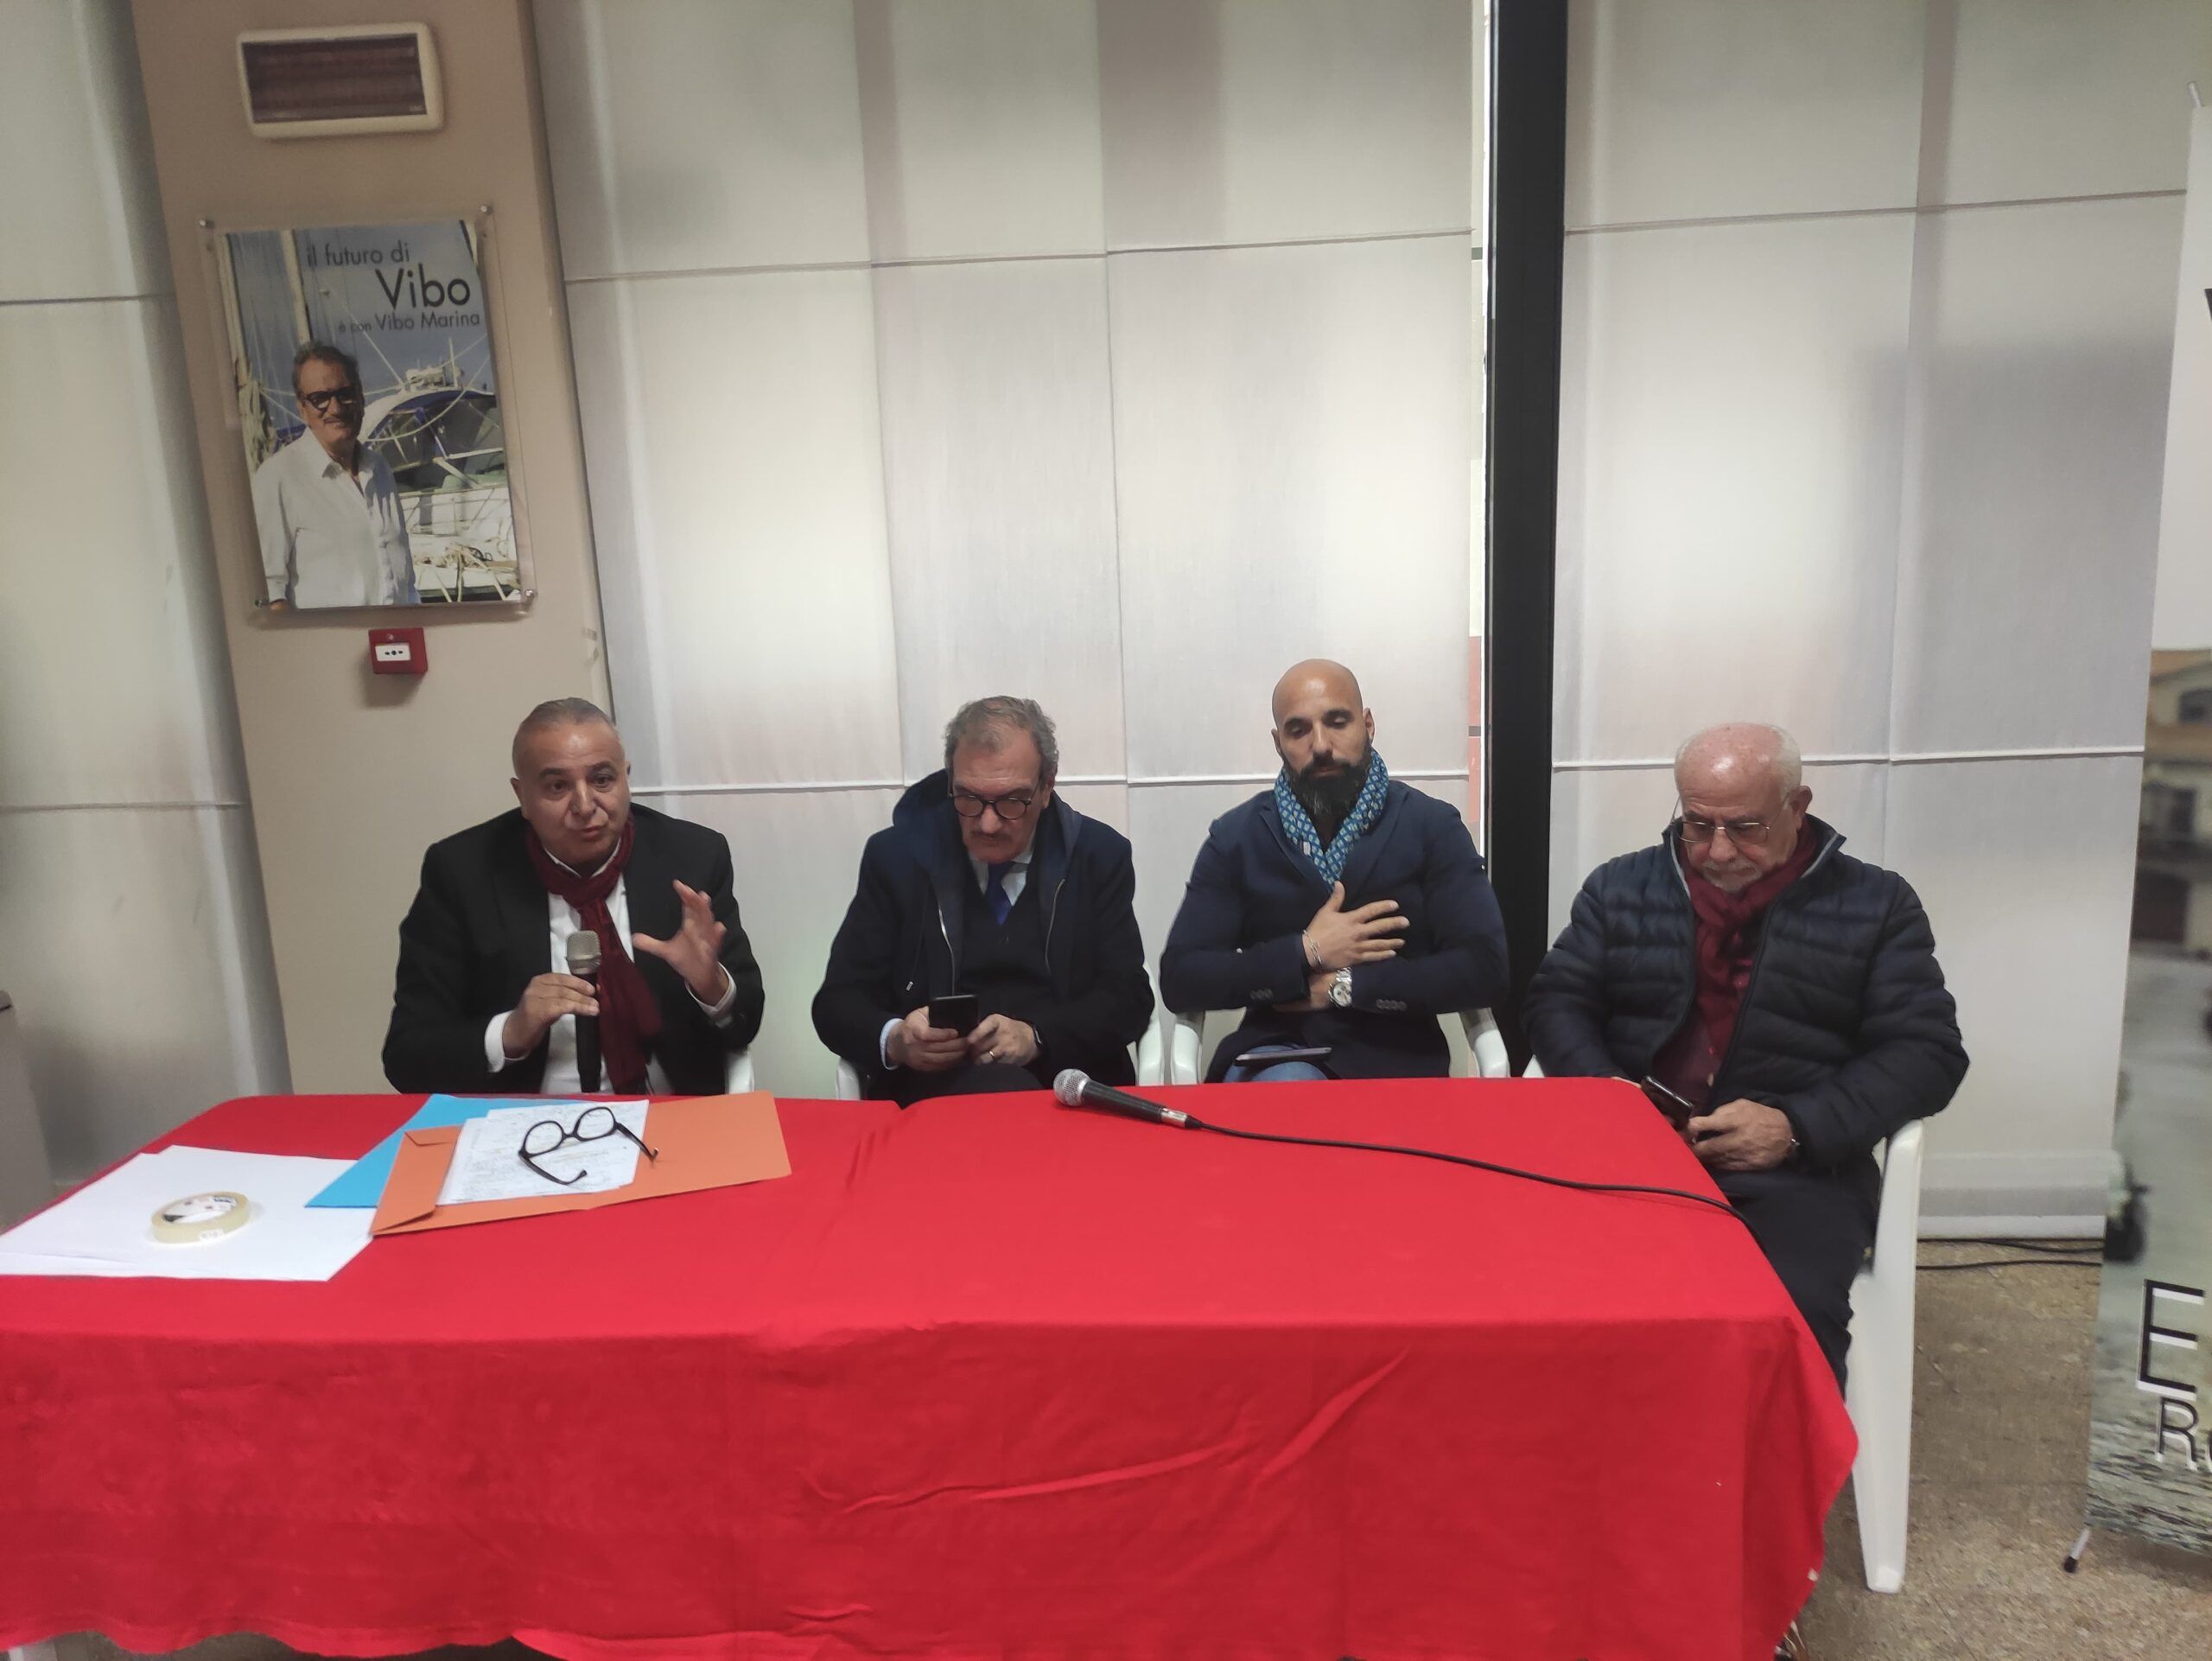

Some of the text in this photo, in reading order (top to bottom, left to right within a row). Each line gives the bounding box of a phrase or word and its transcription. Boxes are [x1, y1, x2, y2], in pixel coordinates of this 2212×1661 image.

[325, 243, 384, 266] futuro
[391, 239, 410, 263] di
[375, 263, 471, 309] Vibo
[350, 321, 372, 332] con
[374, 312, 415, 330] Vibo
[421, 310, 480, 328] Marina
